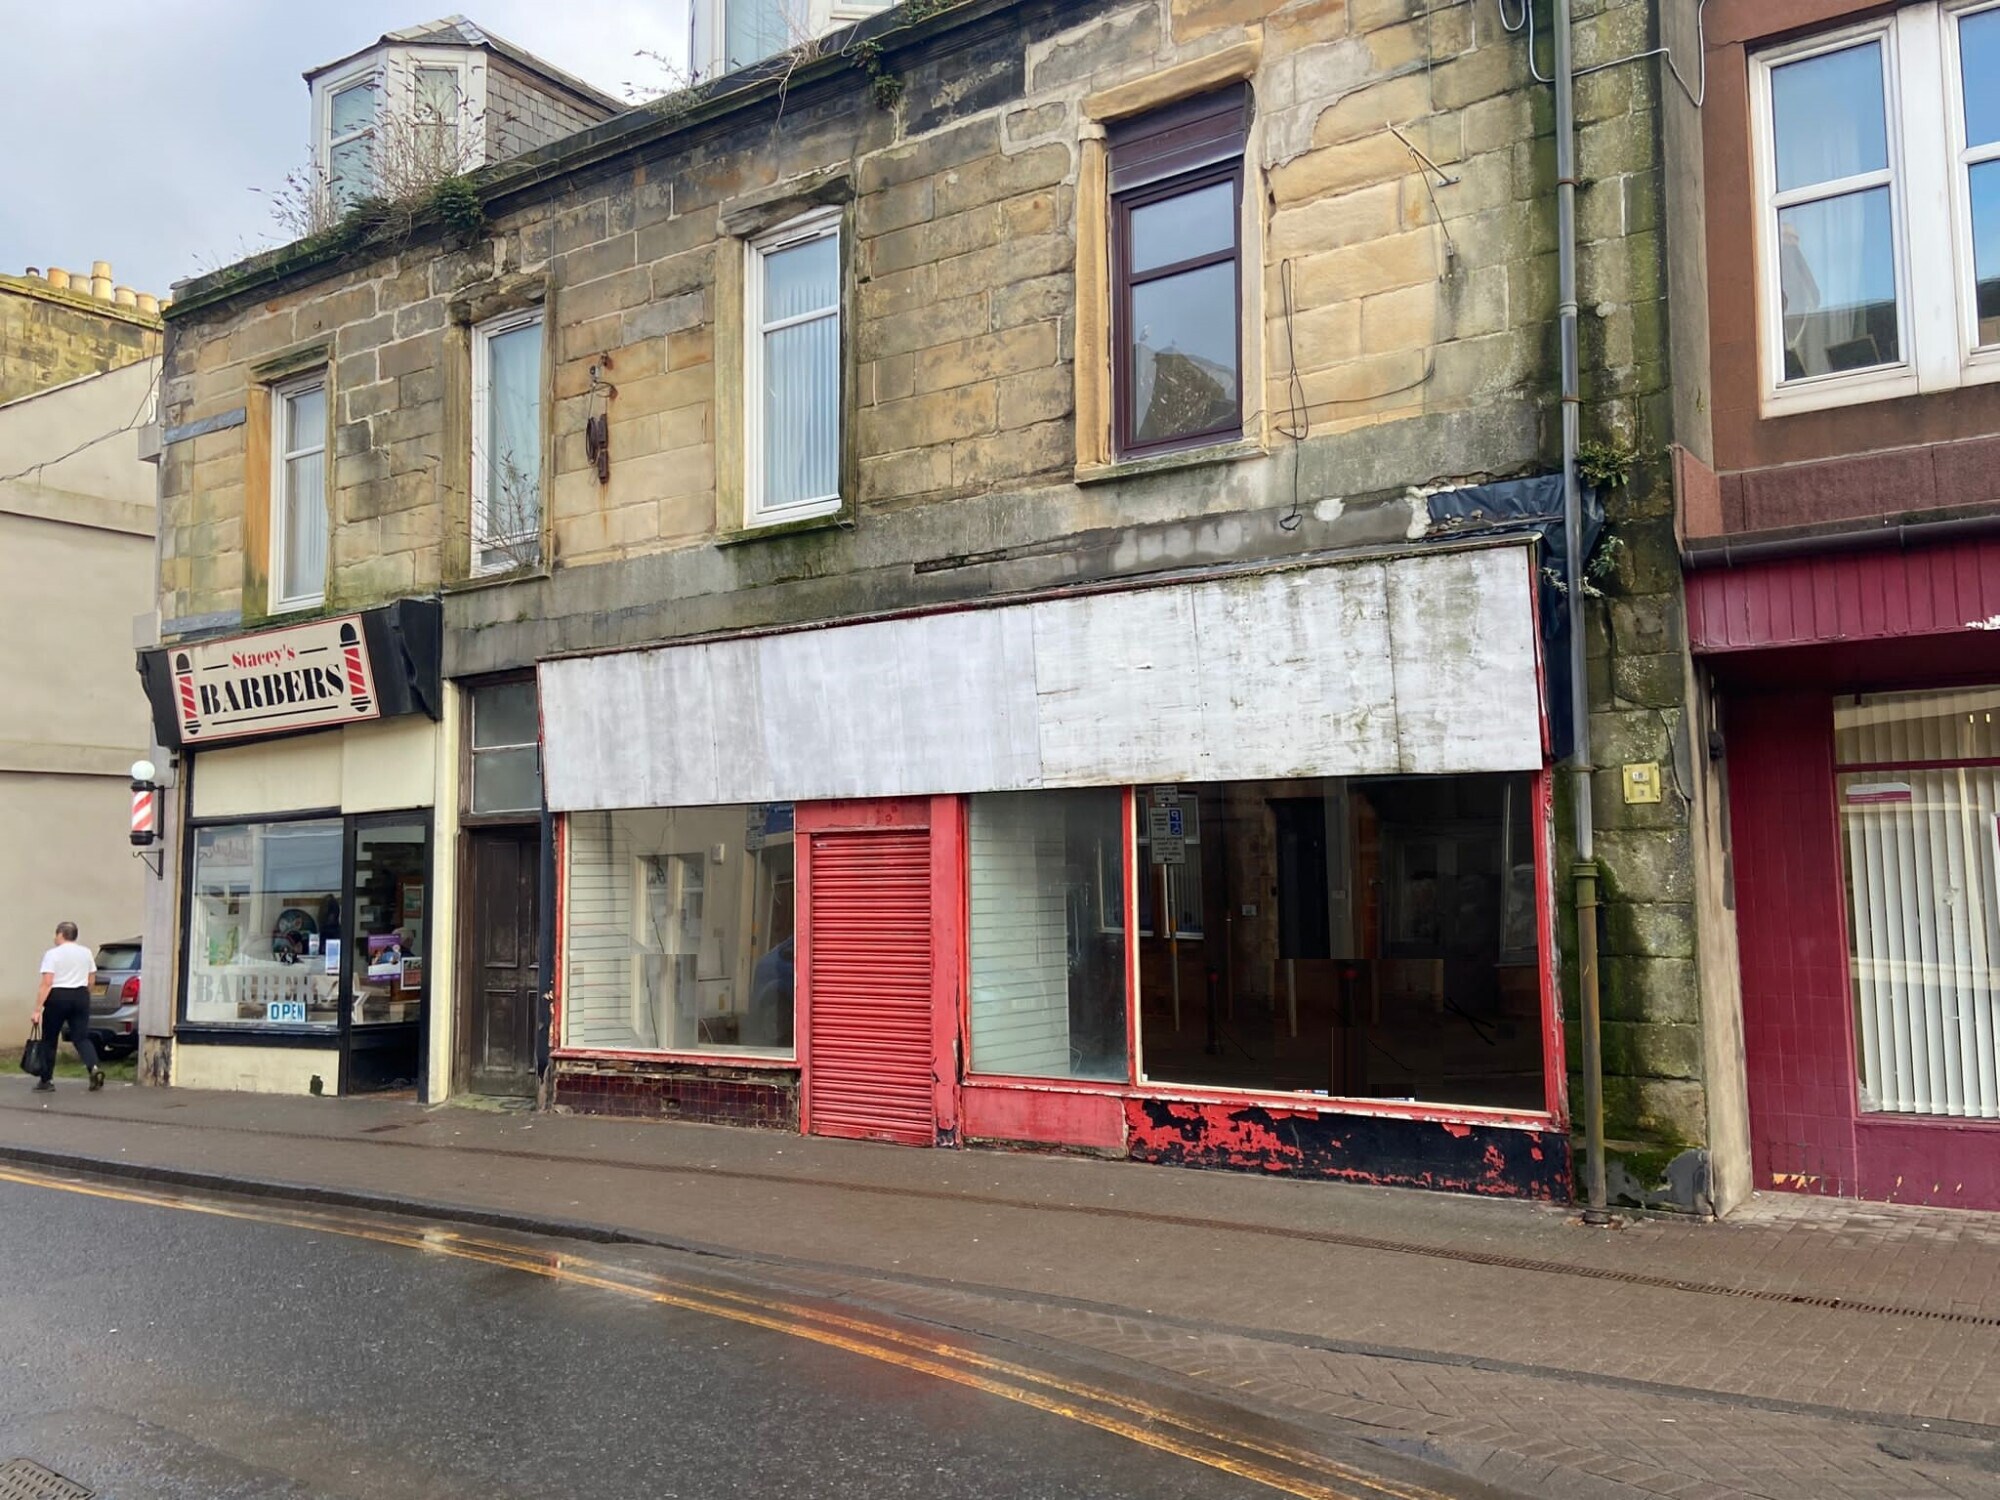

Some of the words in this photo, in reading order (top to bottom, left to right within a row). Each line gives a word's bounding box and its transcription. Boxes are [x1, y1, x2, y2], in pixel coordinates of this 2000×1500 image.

[231, 644, 296, 669] Stacey's
[199, 663, 345, 715] BARBERS
[270, 1003, 304, 1020] OPEN
